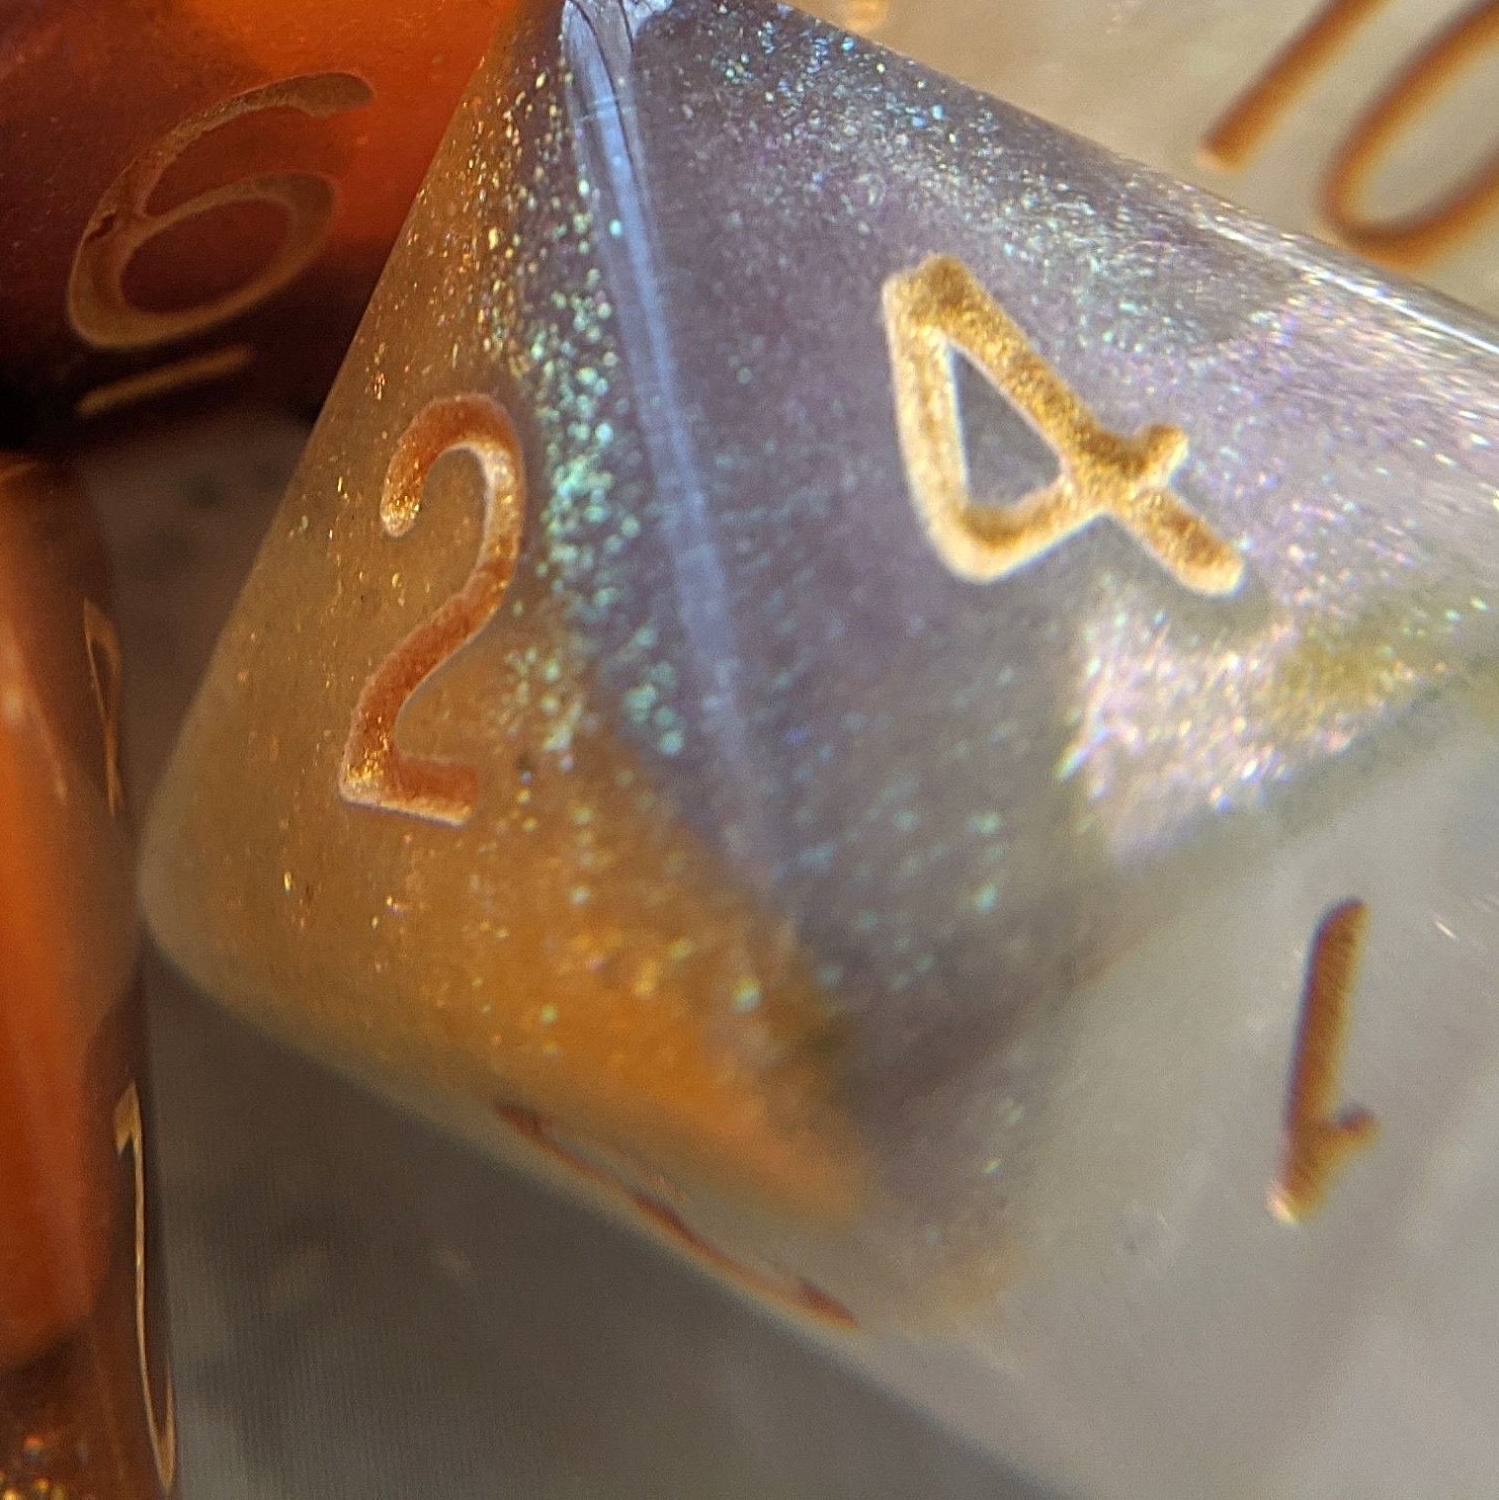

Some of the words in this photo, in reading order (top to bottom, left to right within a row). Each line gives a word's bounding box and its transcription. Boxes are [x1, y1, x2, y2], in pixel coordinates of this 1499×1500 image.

[69, 68, 376, 350] 6
[882, 253, 1248, 596] 4
[339, 393, 525, 826] 2
[1266, 896, 1380, 1224] 1
